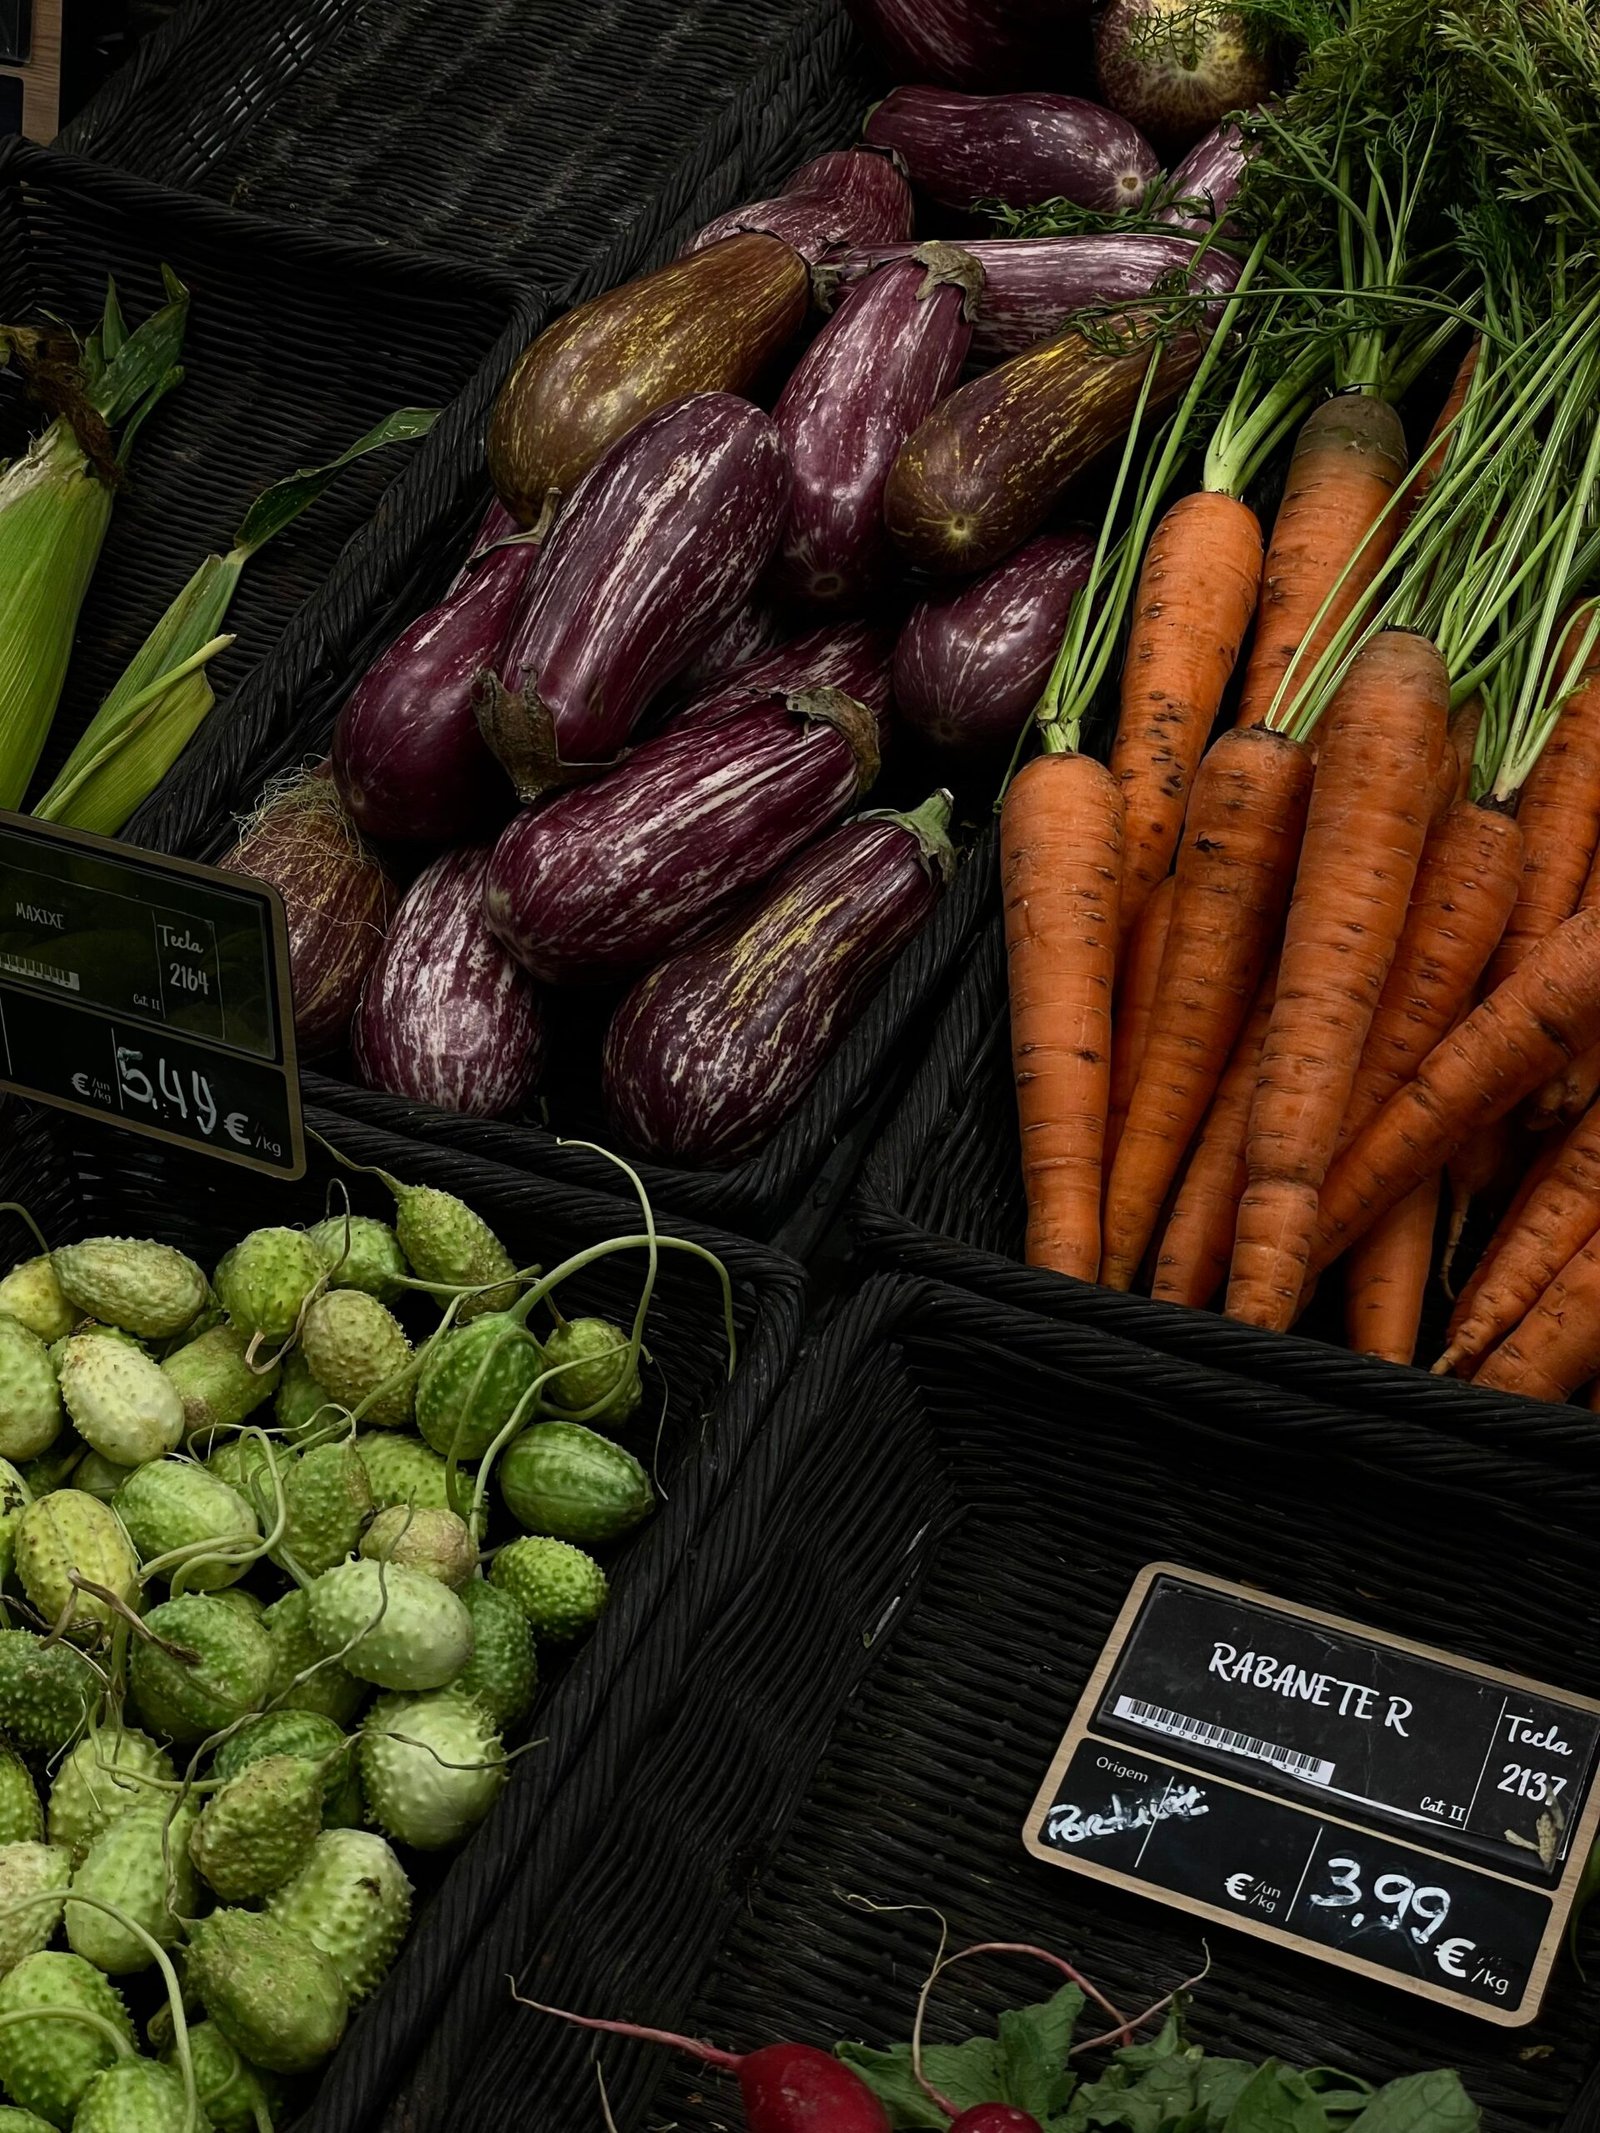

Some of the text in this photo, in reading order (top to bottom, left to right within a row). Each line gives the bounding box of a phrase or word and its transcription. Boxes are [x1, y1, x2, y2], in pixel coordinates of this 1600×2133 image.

[16, 902, 65, 930] MAXIXE
[157, 923, 203, 954] Tecla
[170, 962, 209, 995] 2164
[71, 1072, 91, 1096] €
[1505, 1714, 1573, 1756] Tecla
[1096, 1755, 1148, 1785] Origem
[1497, 1763, 1568, 1806] 2137
[1448, 1805, 1466, 1822] II
[1224, 1871, 1282, 1902] € /un
[1249, 1896, 1277, 1914] /kg
[1309, 1857, 1510, 1996] 3,99 € /kg
